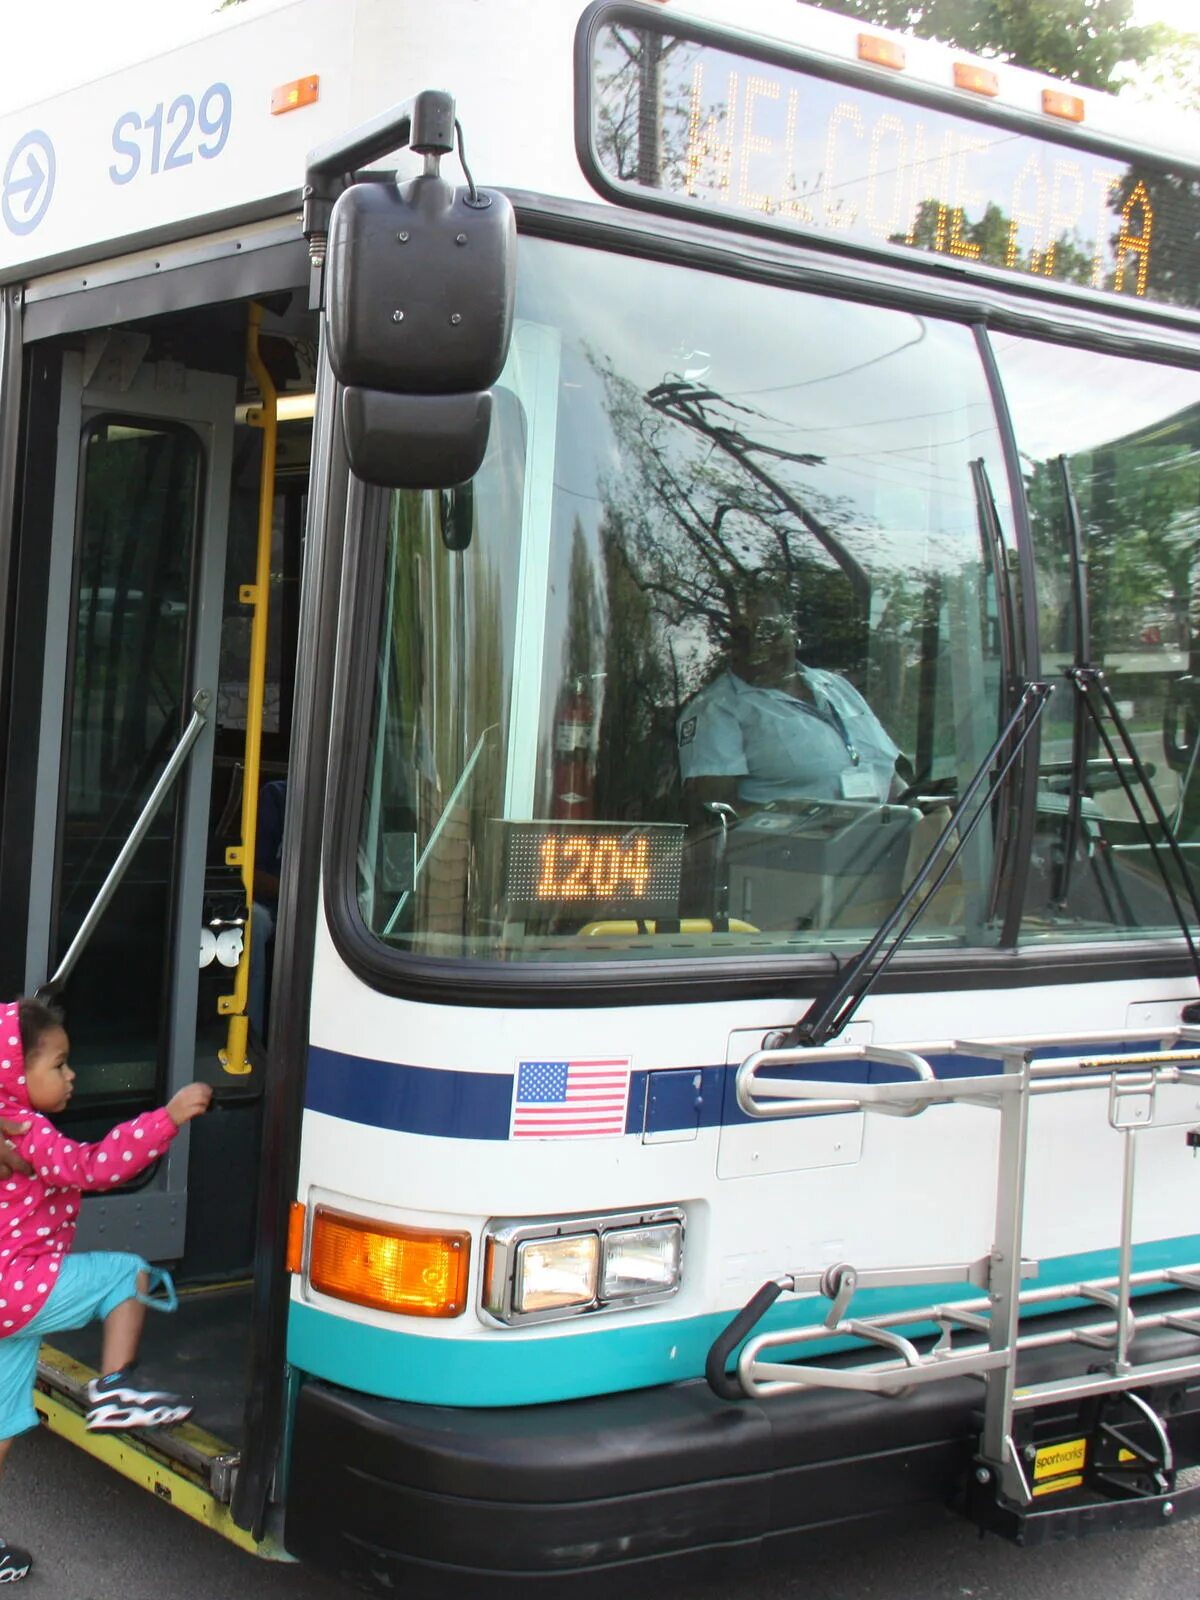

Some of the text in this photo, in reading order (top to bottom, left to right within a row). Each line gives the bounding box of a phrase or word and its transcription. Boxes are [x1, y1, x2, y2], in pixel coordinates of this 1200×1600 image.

[108, 81, 232, 186] S129
[686, 62, 1153, 297] WELCOME APTA
[537, 837, 650, 897] 1204
